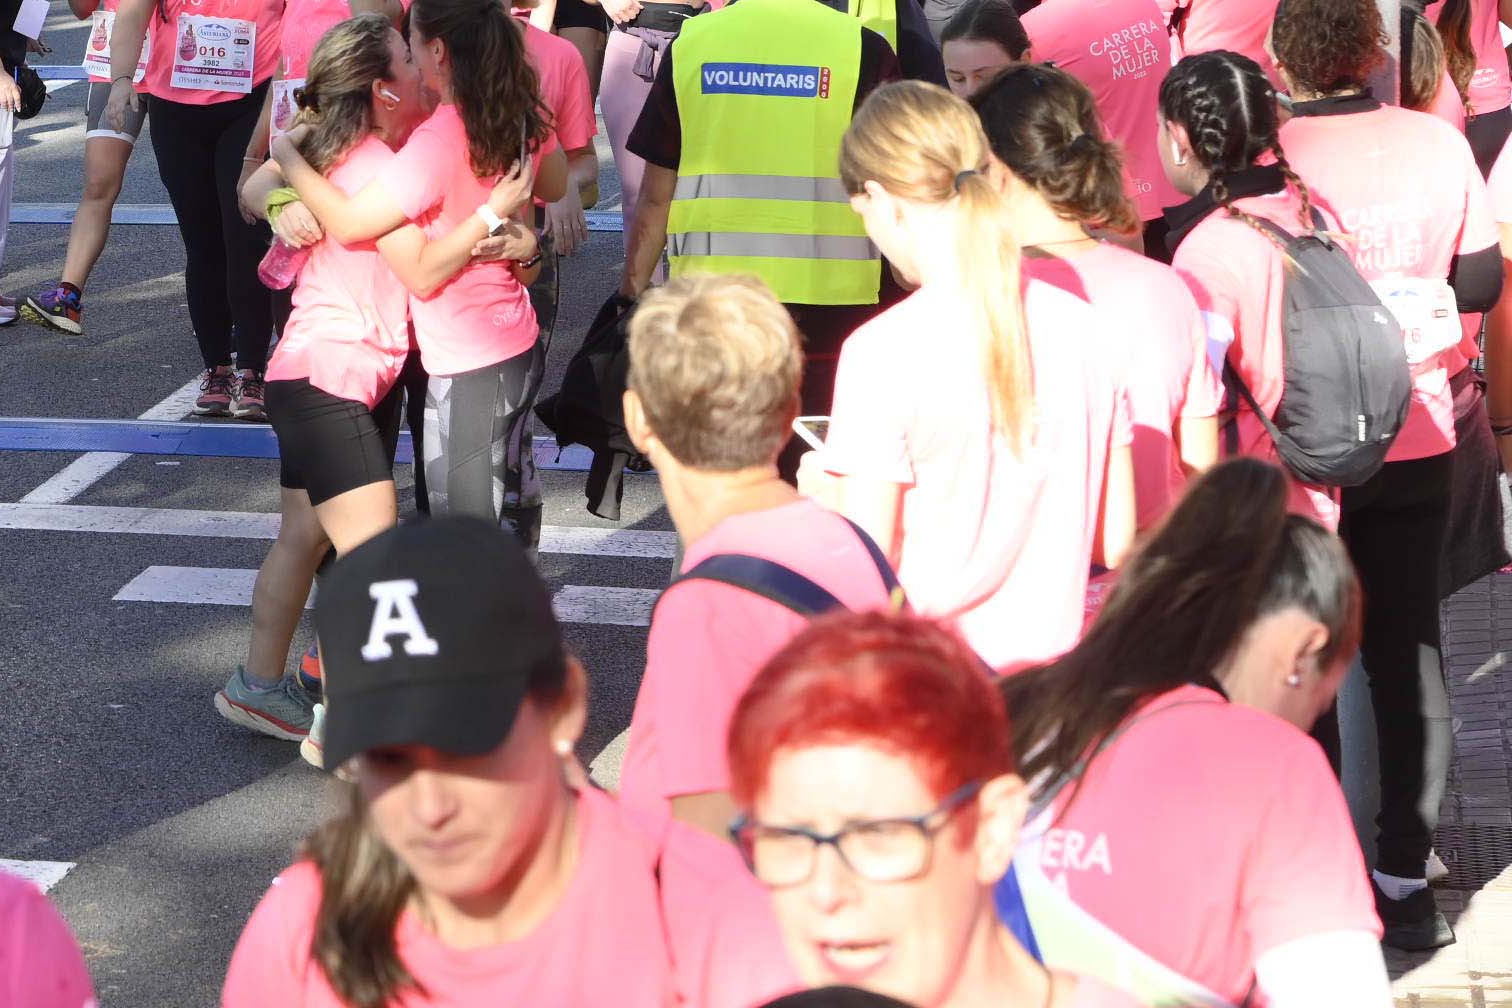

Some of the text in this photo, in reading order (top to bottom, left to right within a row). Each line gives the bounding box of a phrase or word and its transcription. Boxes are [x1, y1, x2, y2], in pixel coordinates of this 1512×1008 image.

[199, 46, 226, 58] 016
[1089, 18, 1160, 57] CARRERA
[1109, 37, 1155, 64] DE LA
[202, 59, 220, 67] 3982
[1111, 49, 1160, 80] MUJER
[703, 67, 829, 99] VOLUNTARIS 2000
[361, 579, 439, 660] A
